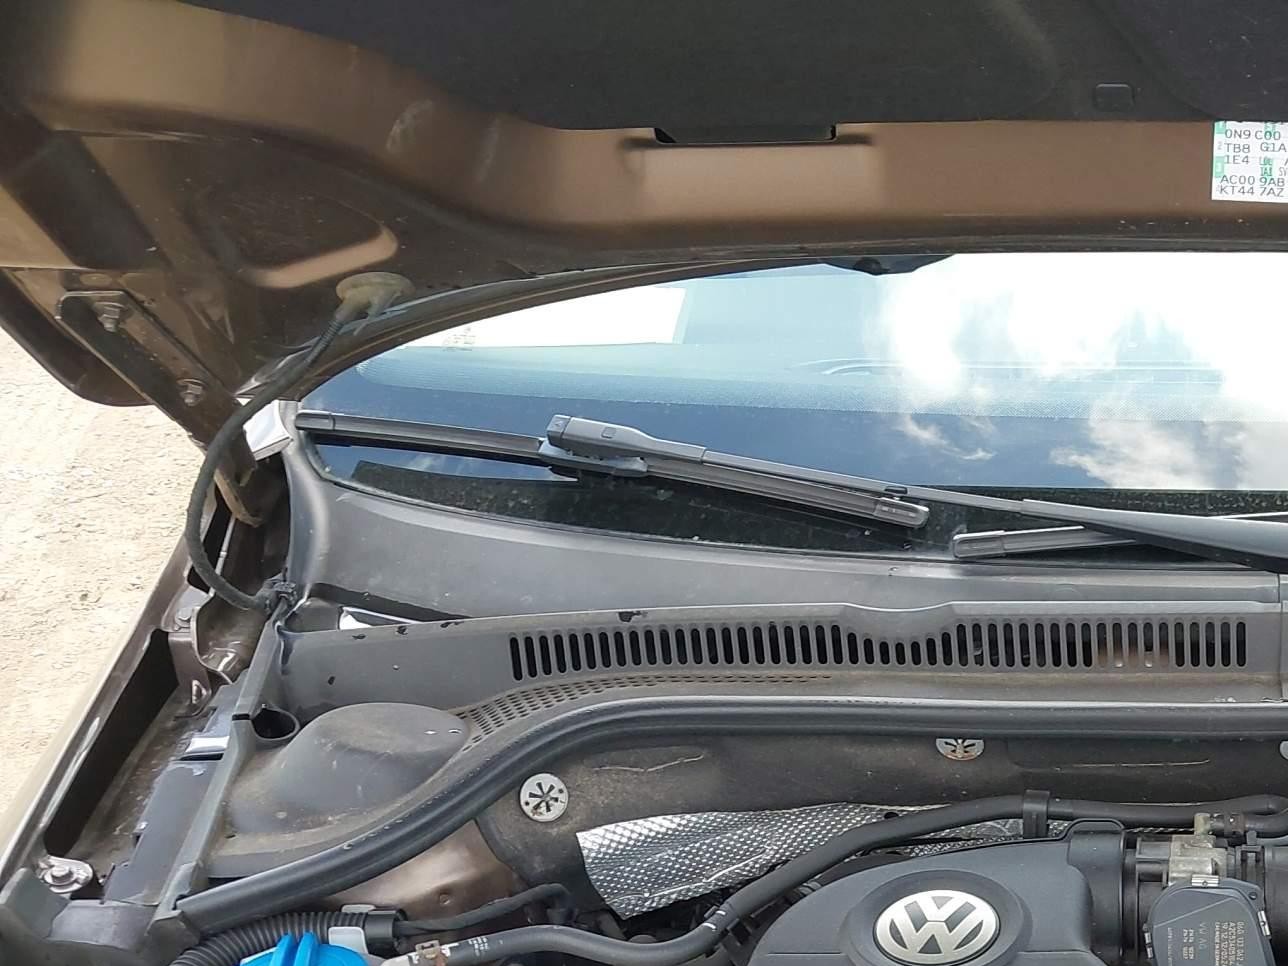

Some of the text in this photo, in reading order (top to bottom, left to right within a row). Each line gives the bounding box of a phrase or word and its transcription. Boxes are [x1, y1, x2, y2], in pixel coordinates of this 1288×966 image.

[1223, 142, 1250, 154] TB8
[1260, 142, 1287, 153] G1A
[1223, 155, 1250, 165] 1E4
[1220, 174, 1256, 185] AC00
[1259, 176, 1285, 187] 9AB
[1219, 184, 1255, 195] KT44
[1259, 186, 1284, 197] 7AZ
